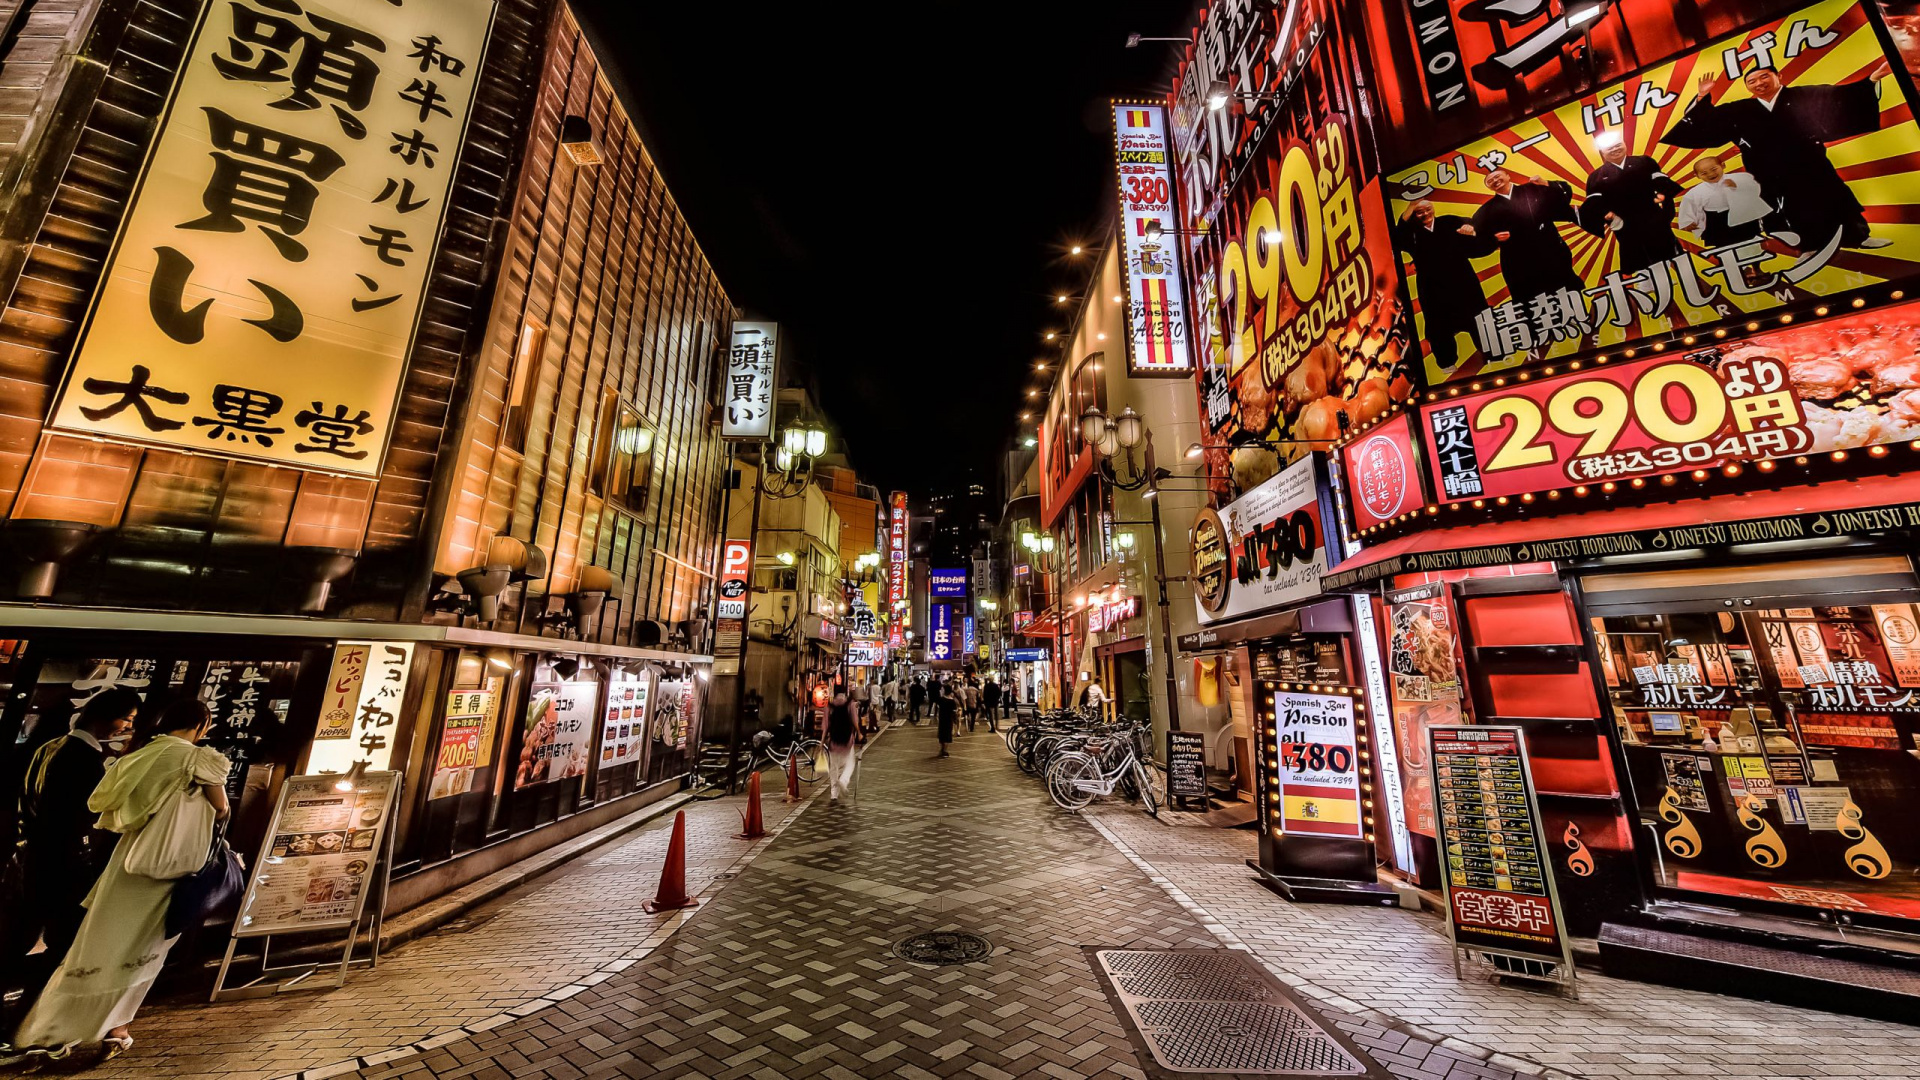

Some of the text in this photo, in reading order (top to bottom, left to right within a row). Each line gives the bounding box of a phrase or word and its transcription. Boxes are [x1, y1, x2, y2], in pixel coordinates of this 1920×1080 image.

[1400, 19, 1839, 201] こりゃー げん げん
[1120, 140, 1163, 150] Pasion
[1121, 151, 1164, 163] スペイン酒場
[351, 34, 466, 313] 和牛ホルモン
[1120, 165, 1167, 174] 全品均一
[1121, 176, 1169, 204] ¥380
[1474, 223, 1843, 359] 情熱ホルモン
[1133, 306, 1181, 319] Pasion
[1261, 252, 1371, 388] (税込304円)
[728, 329, 761, 426] 一頭買い
[757, 336, 775, 418] 和牛ホルモン
[79, 364, 374, 461] 大黒堂
[1432, 406, 1483, 497] 炭火七輪
[1566, 426, 1810, 480] (税込304円)
[1370, 447, 1391, 512] 新鮮ホルモン
[892, 508, 904, 550] 歌広場
[1669, 518, 1805, 549] JONETSU HORUMON
[1832, 507, 1903, 536] JONETSU
[724, 545, 748, 575] P
[1196, 546, 1227, 576] Pasion
[1418, 546, 1512, 572] JONETSU HORUMON
[1532, 533, 1643, 562] JONETSU HORUMON
[726, 588, 744, 596] NET
[932, 576, 965, 584] 日本の台所
[1274, 574, 1299, 594] included
[719, 603, 742, 616] ¥100
[934, 628, 949, 659] 庄や
[336, 648, 363, 709] ホッピー
[1656, 663, 1702, 685] 情熱
[1826, 661, 1882, 685] 情熱
[452, 694, 481, 714] 早得
[555, 698, 576, 712] ココが
[1281, 697, 1347, 711] Spanish Bar
[1641, 683, 1726, 705] ホルモン
[1808, 684, 1913, 708] ホルモン
[1283, 708, 1348, 727] Pasion
[1281, 730, 1306, 744] all
[440, 742, 476, 767] 200円
[1283, 742, 1353, 774] ¥380
[1292, 774, 1303, 782] tax
[1304, 774, 1331, 784] included
[1747, 778, 1772, 788] STOP
[1455, 891, 1550, 932] 営業中
